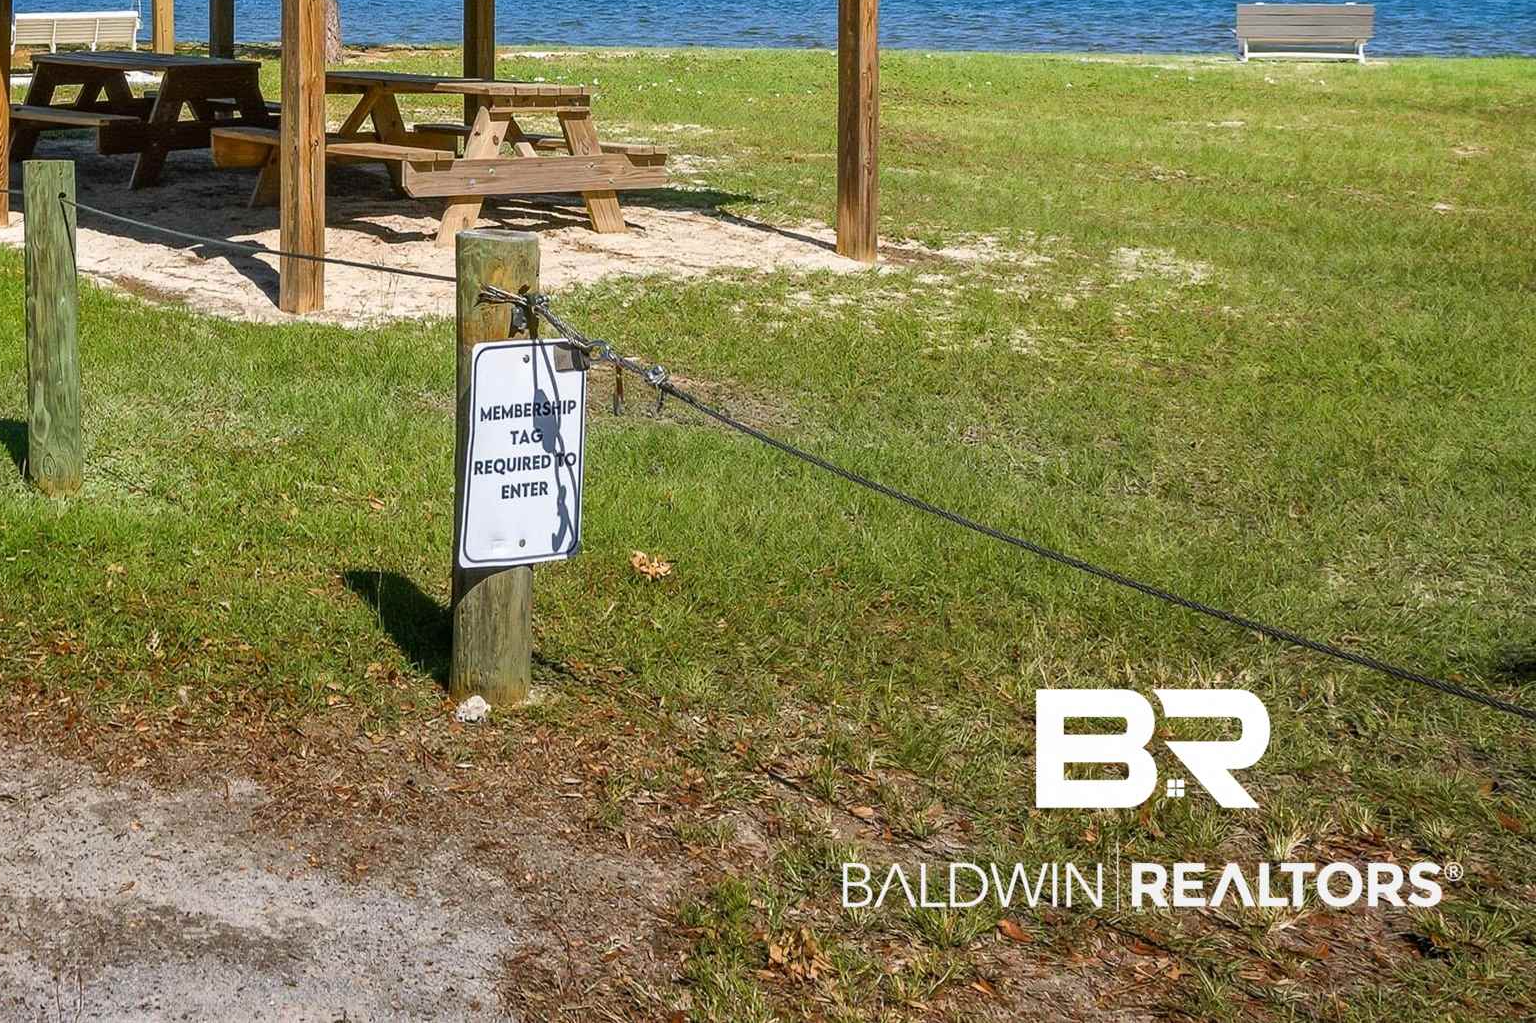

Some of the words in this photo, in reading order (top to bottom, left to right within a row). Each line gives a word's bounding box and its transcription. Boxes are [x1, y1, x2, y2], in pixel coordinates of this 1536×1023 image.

[480, 400, 577, 422] MEMBERSHIP
[510, 430, 544, 445] TAG
[473, 455, 552, 475] REQUIRED
[556, 453, 577, 468] TO
[501, 481, 549, 499] ENTER
